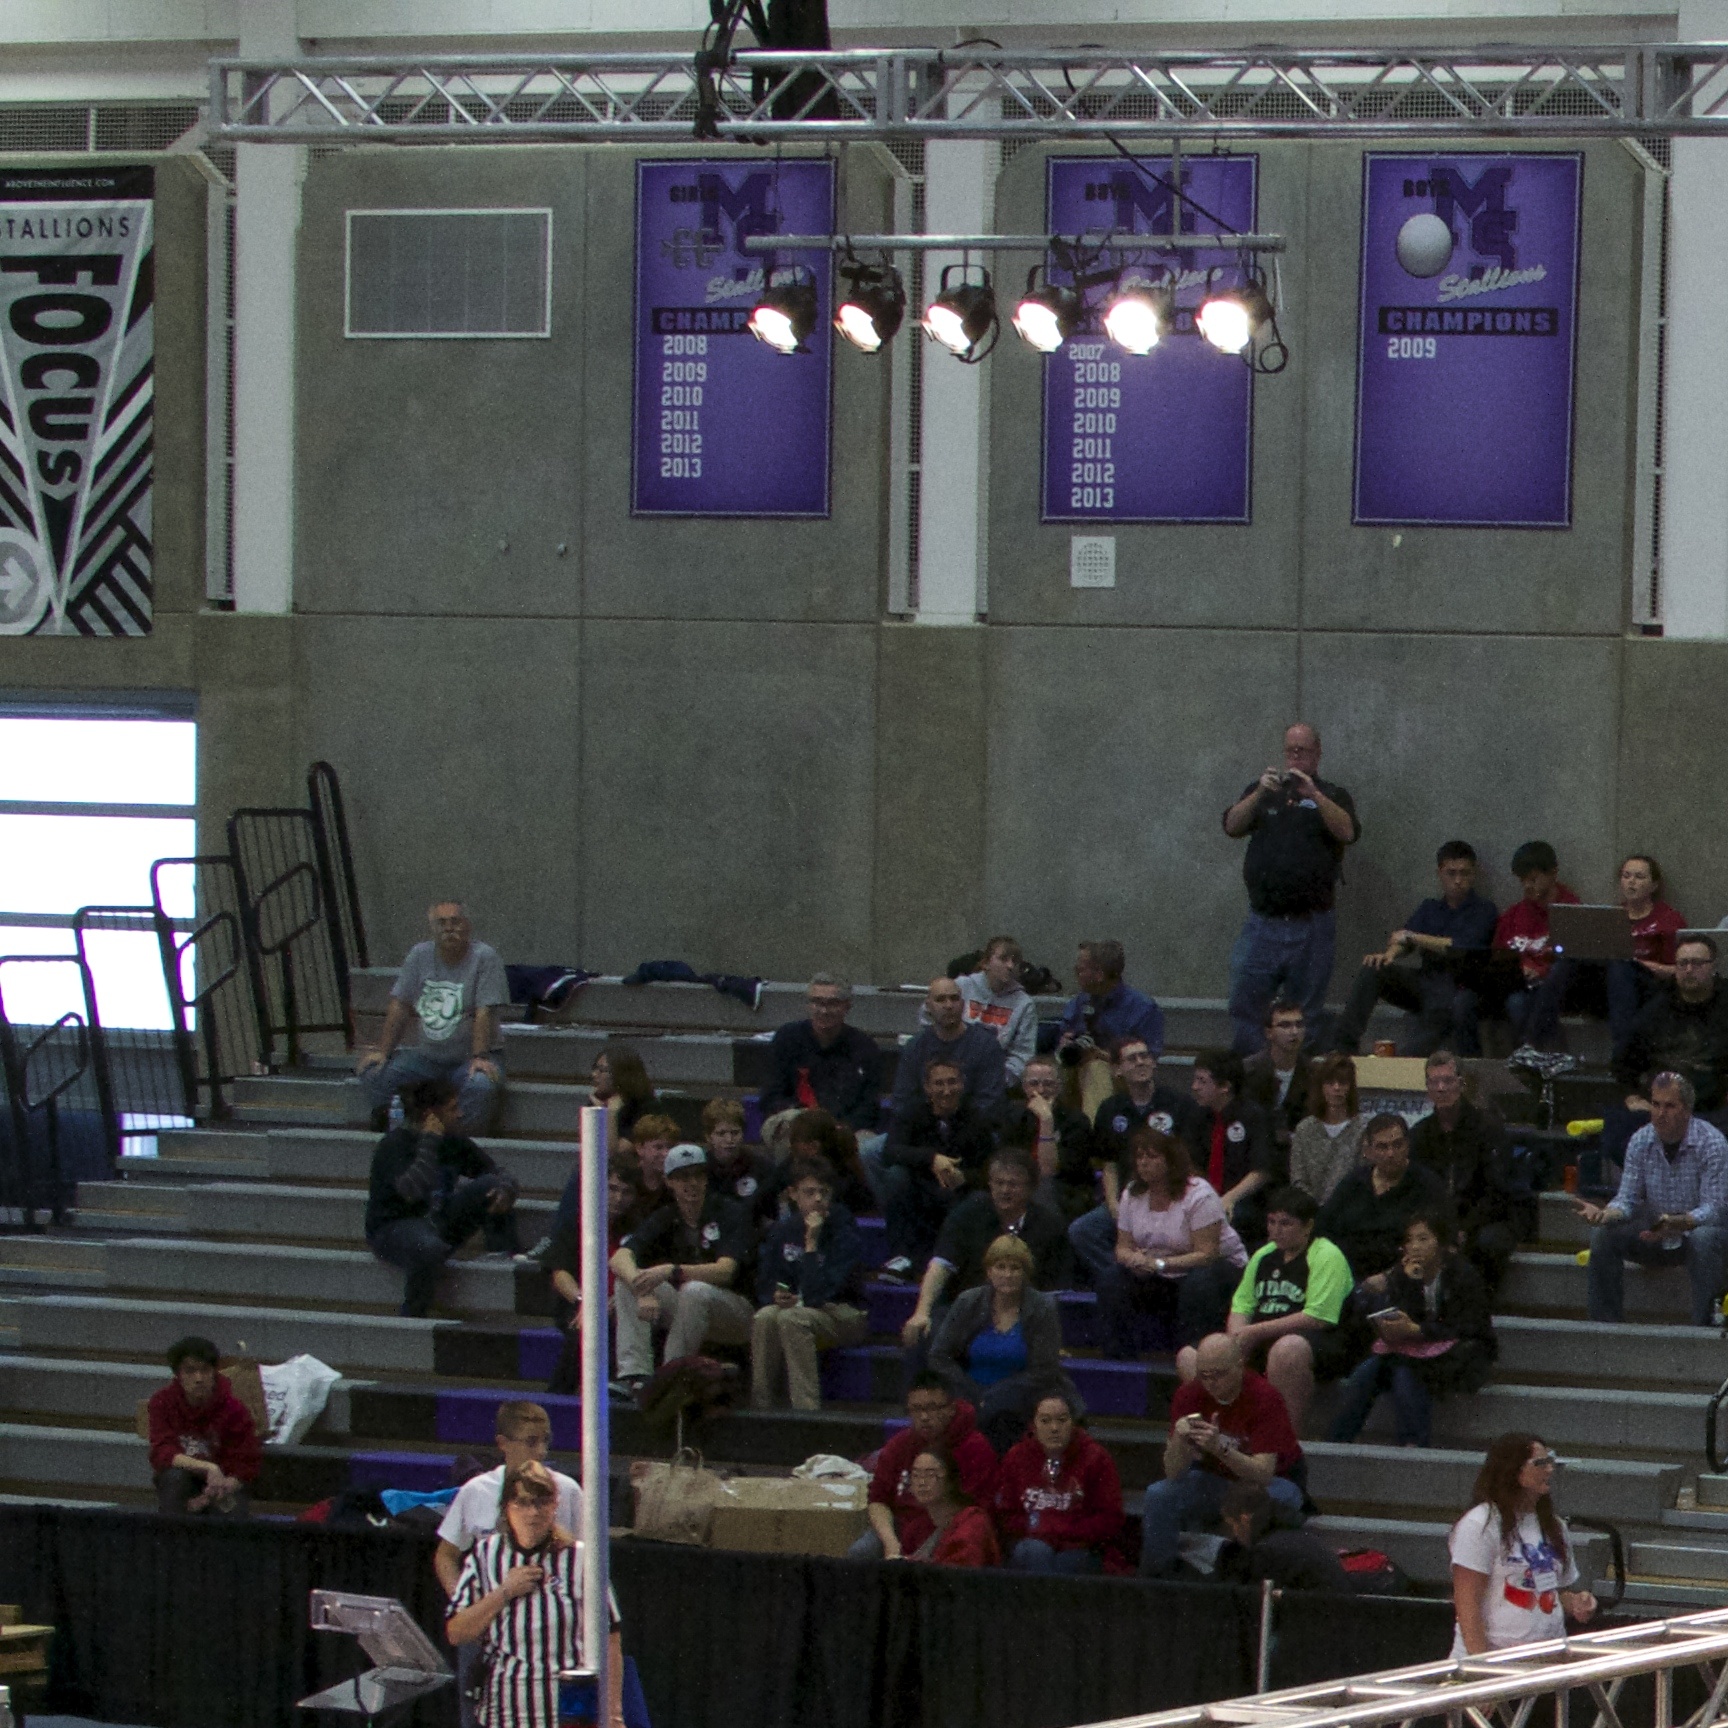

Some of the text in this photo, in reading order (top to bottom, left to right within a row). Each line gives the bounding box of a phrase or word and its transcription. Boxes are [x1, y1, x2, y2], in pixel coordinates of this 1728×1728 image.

[0, 216, 130, 239] TALLIONS
[1437, 264, 1547, 303] Stallions
[1387, 311, 1550, 331] CHAMPIONS
[663, 335, 707, 355] 2008
[1388, 337, 1436, 359] 2009
[0, 254, 123, 486] FOCUS
[662, 362, 707, 382] 2009
[1074, 362, 1120, 383] 2008
[662, 386, 703, 406] 2010
[1074, 388, 1120, 408] 2009
[661, 410, 699, 430] 2011
[1073, 413, 1116, 434] 2010
[661, 434, 702, 453] 2012
[1073, 438, 1111, 458] 2011
[661, 457, 702, 477] 2013
[1072, 463, 1115, 483] 2012
[1071, 487, 1114, 508] 2013
